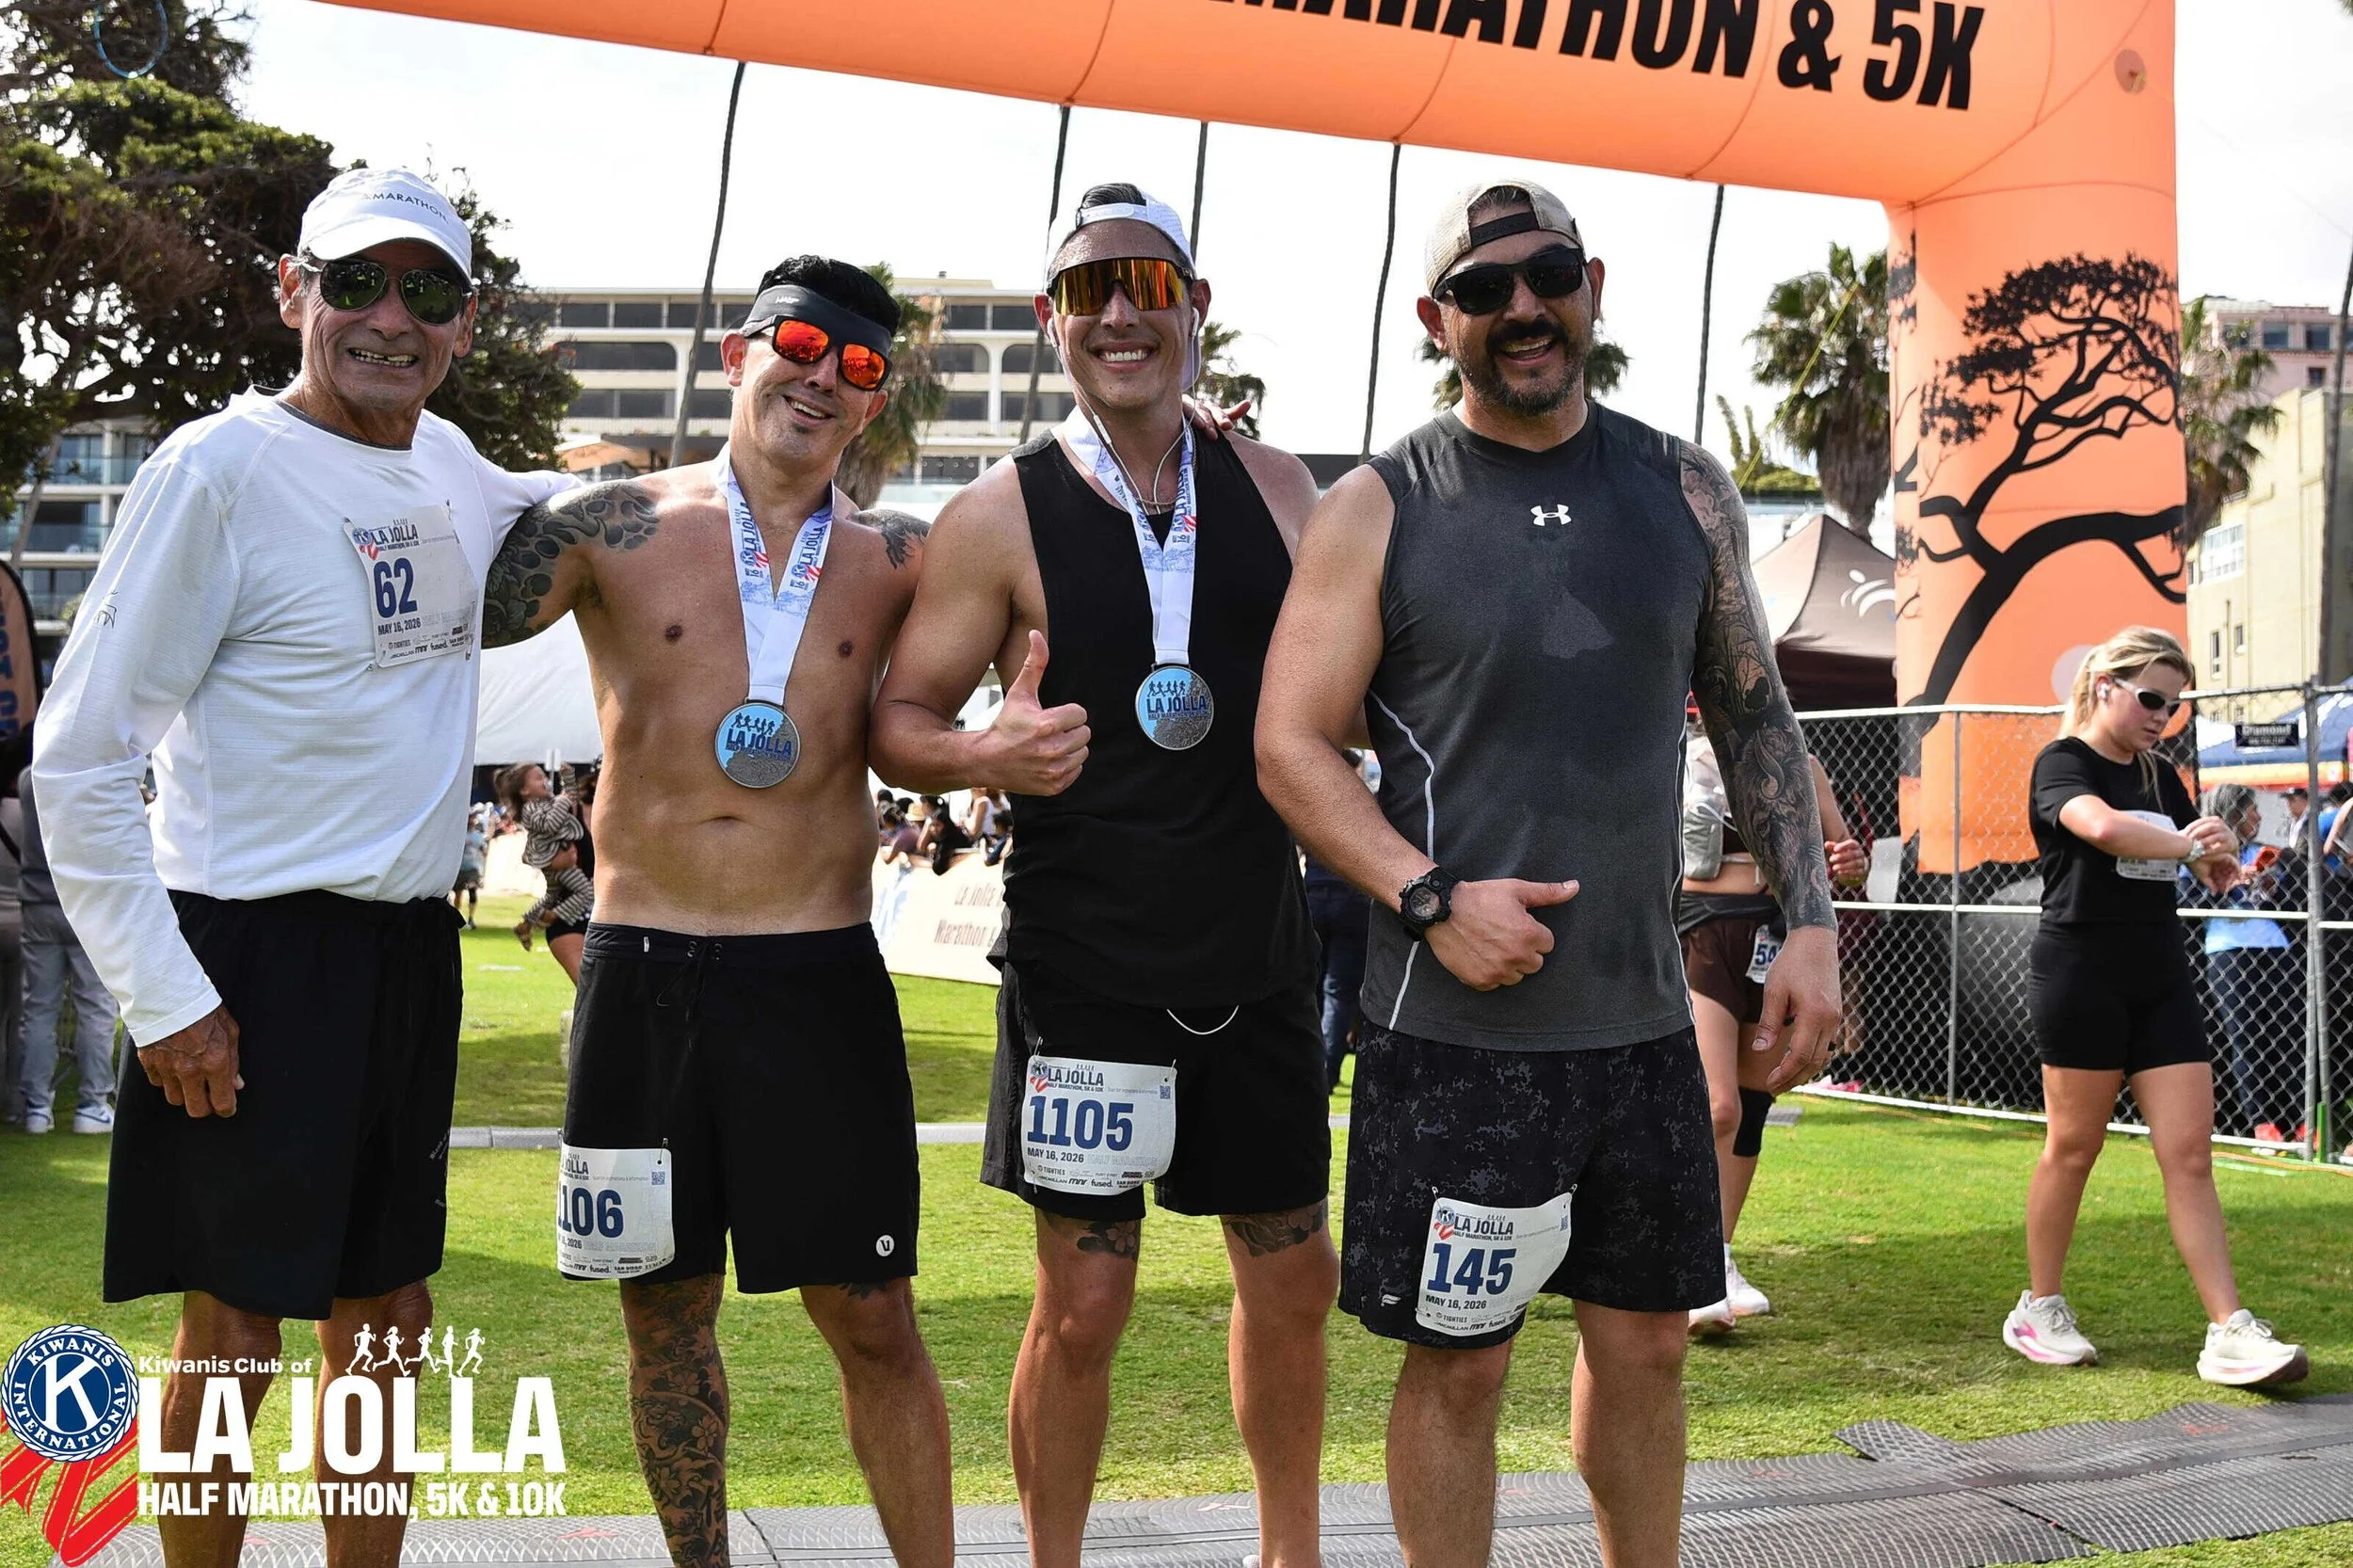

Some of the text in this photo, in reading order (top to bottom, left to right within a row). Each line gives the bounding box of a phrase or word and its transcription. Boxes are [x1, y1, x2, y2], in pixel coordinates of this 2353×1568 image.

[1209, 0, 1983, 111] THON & 5K
[371, 530, 389, 545] LA
[389, 524, 419, 543] JOLLA
[744, 537, 757, 552] LA
[800, 553, 815, 565] LA
[374, 557, 418, 618] 62
[377, 623, 392, 636] MAY
[393, 621, 405, 634] 16,
[404, 617, 422, 631] 2026
[1146, 696, 1207, 713] LA JOLLA
[726, 729, 745, 747] LA
[748, 733, 792, 756] JOLLA
[1048, 1068, 1104, 1086] LA JOLLA
[1027, 1096, 1134, 1152] 1105
[1027, 1146, 1045, 1159] MAY
[1046, 1150, 1058, 1161] 16,
[1061, 1152, 1084, 1163] 2026
[1091, 1179, 1112, 1188] fused.
[558, 1184, 625, 1239] 106
[1454, 1216, 1470, 1232] LA
[1474, 1218, 1513, 1235] JOLLA
[567, 1238, 583, 1249] 2026
[589, 1264, 612, 1273] fused.
[1427, 1242, 1517, 1296] 145
[1425, 1294, 1487, 1310] MAY 16, 2026
